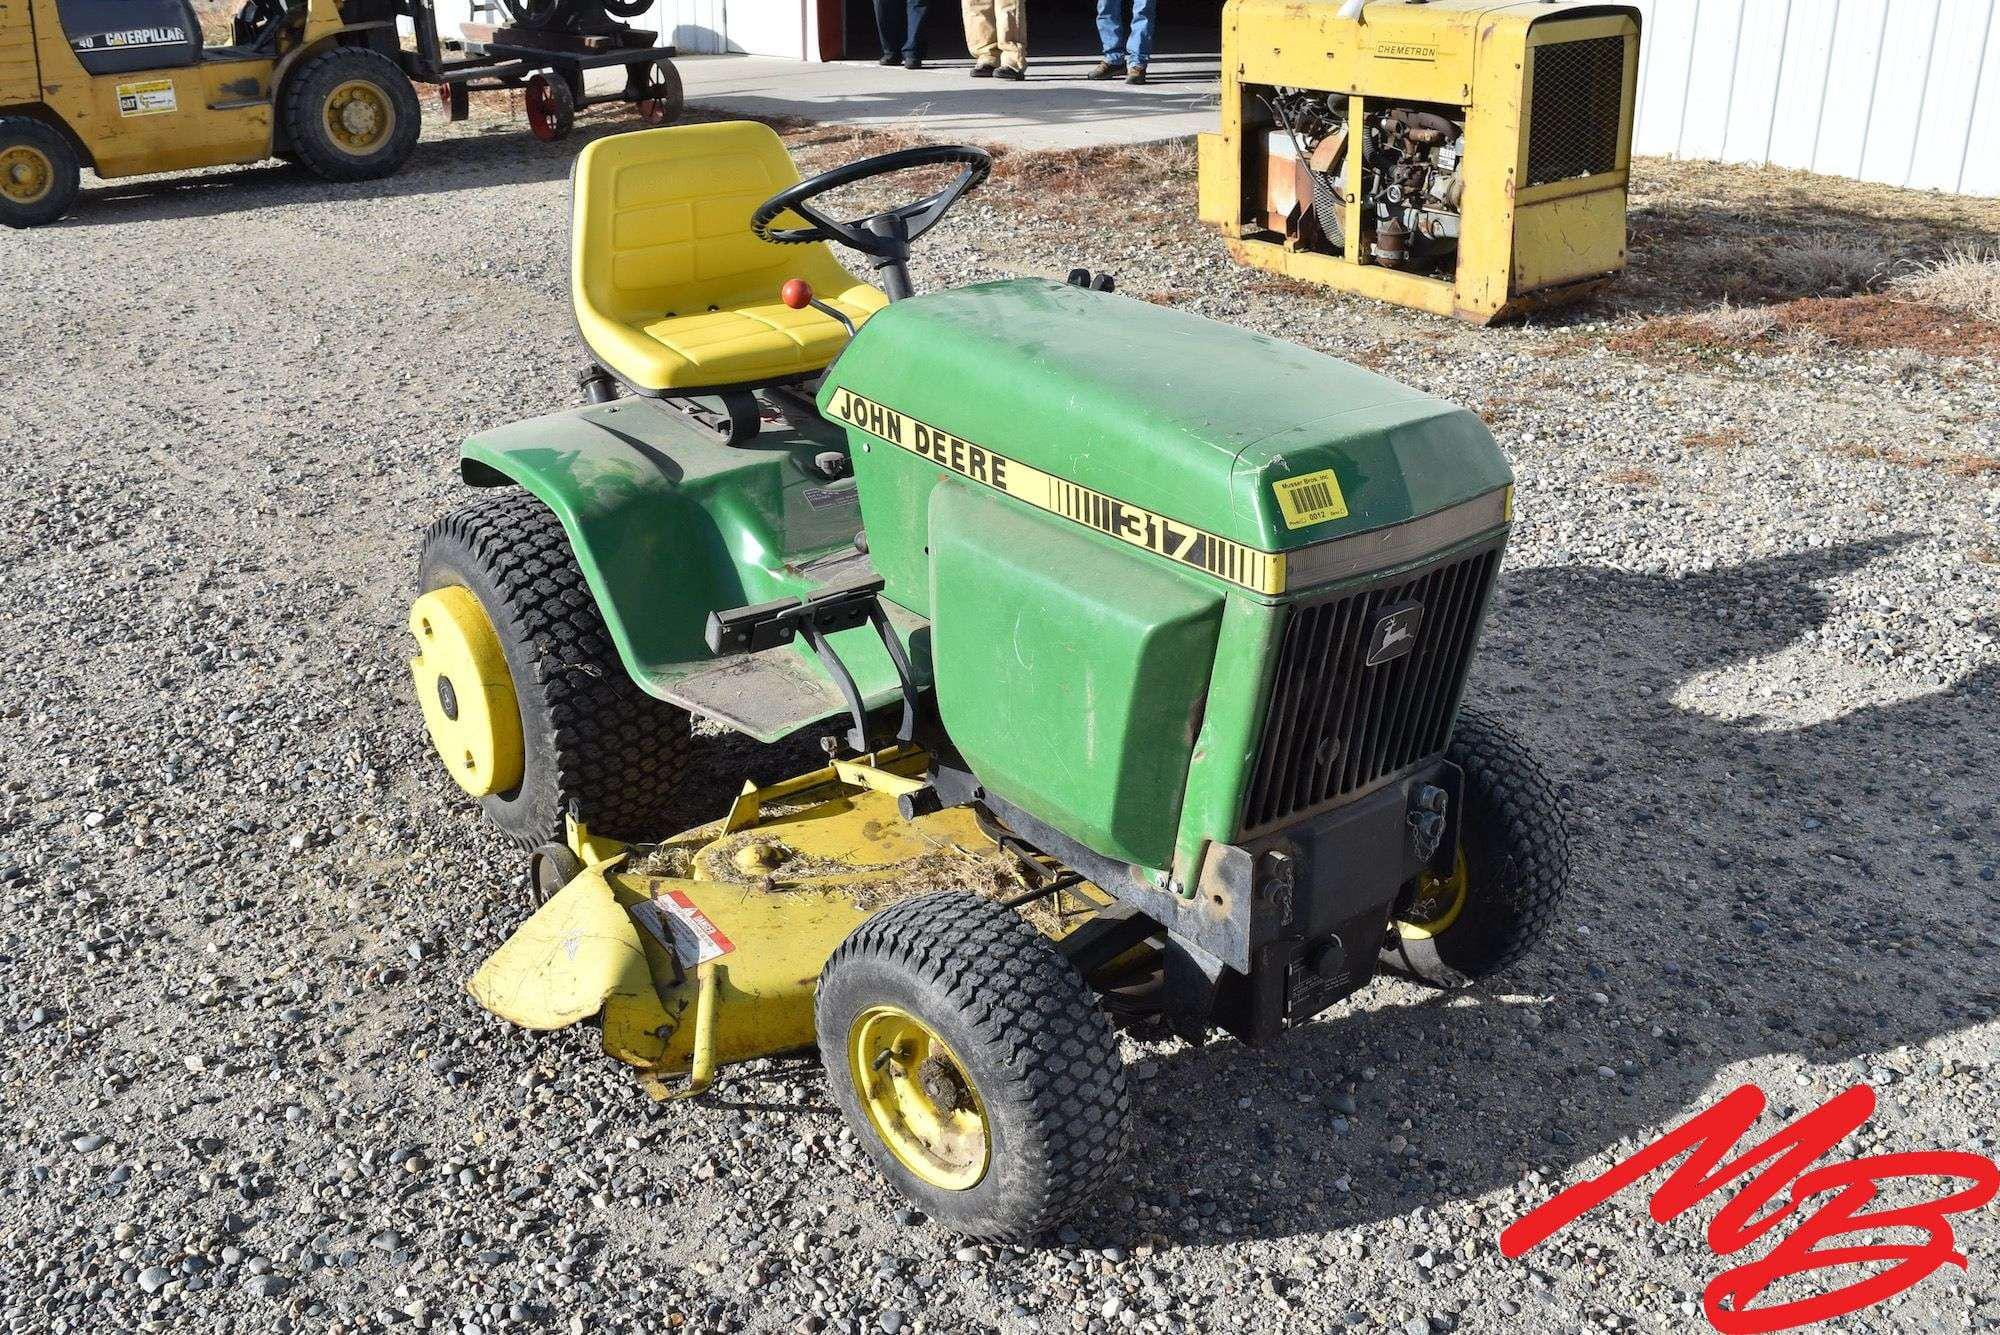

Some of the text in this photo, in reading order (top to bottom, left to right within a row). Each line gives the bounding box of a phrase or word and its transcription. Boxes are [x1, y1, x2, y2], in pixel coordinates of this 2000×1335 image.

[105, 27, 185, 46] CATERPILLAR
[1377, 45, 1436, 57] CHEMETRON
[839, 393, 1008, 490] JOHN DEERE
[1309, 511, 1326, 521] 0012
[1120, 505, 1199, 561] 317
